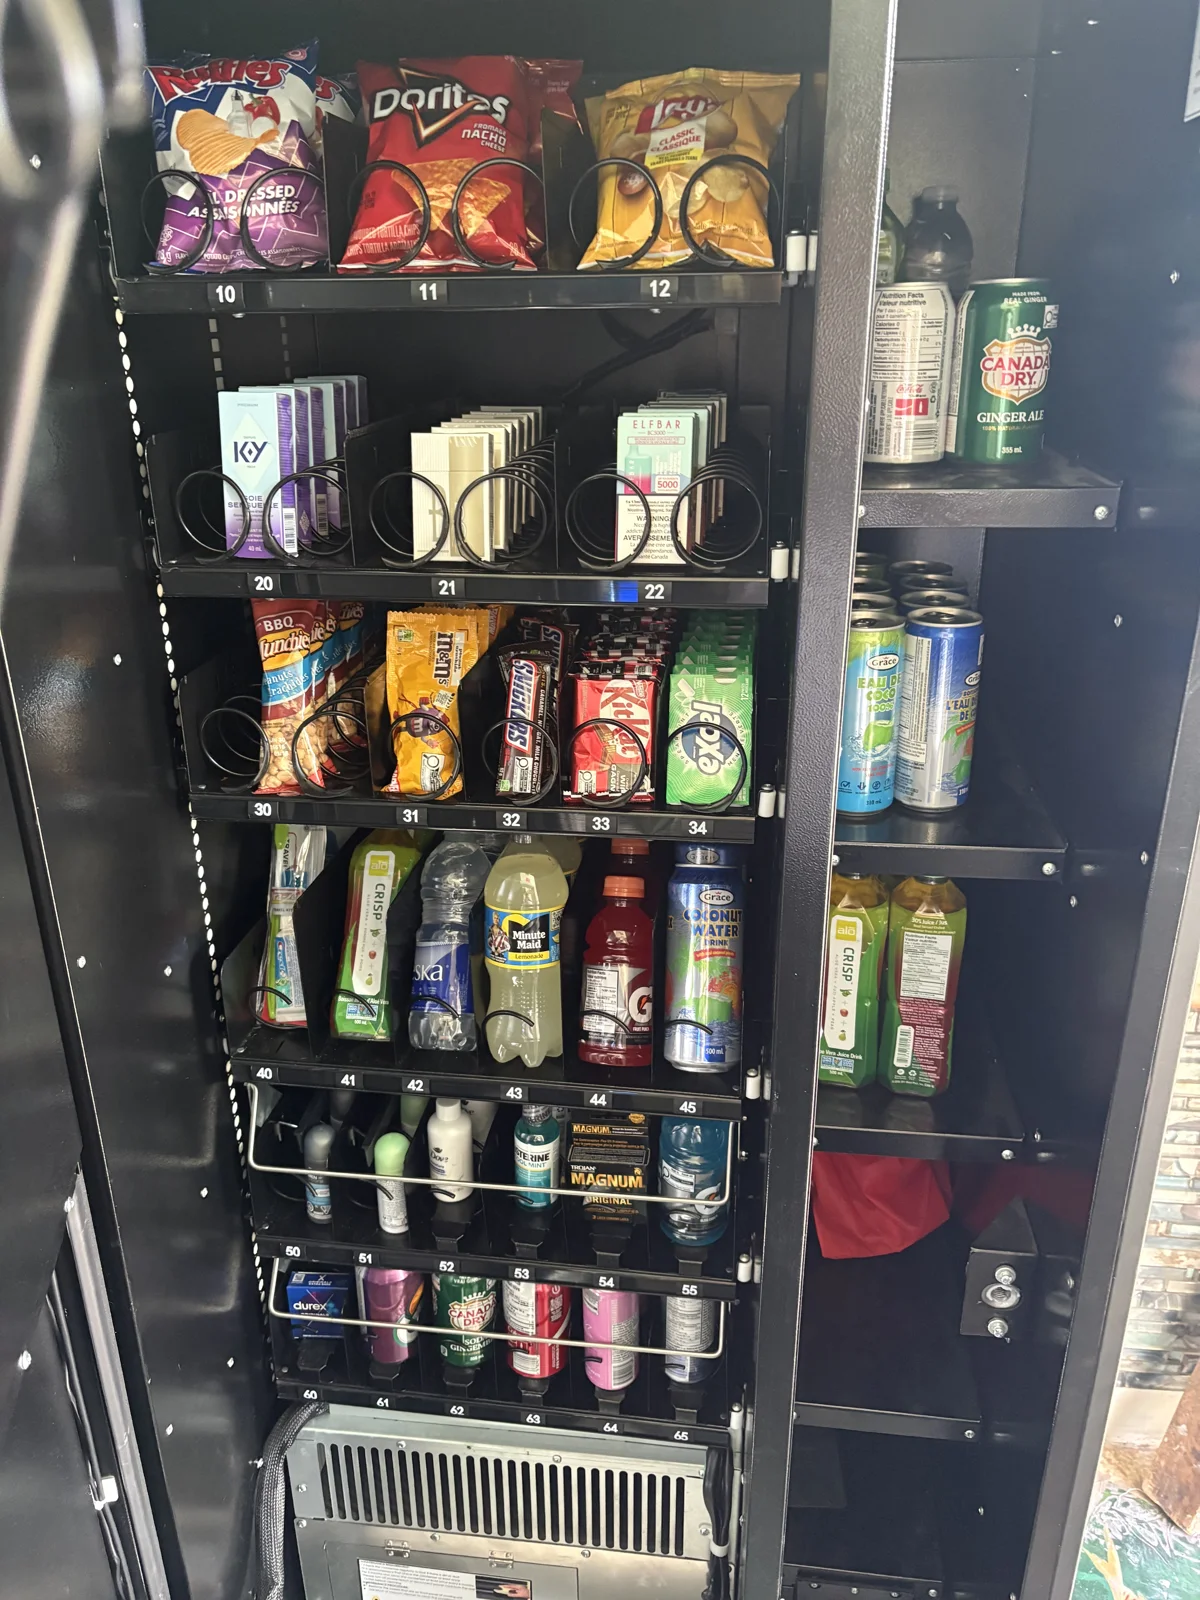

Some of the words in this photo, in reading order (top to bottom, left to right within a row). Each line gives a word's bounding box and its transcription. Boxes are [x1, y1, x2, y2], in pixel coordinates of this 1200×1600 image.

[150, 59, 291, 104] Ruffles
[373, 83, 510, 124] Doritos
[473, 123, 507, 136] FROMAGE
[461, 129, 507, 146] NACHO
[659, 128, 695, 146] CLASSIC
[480, 139, 505, 153] CHEESE
[650, 135, 702, 152] CLASSIQUE
[216, 285, 235, 303] 10
[419, 283, 437, 300] 11
[650, 279, 671, 298] 12
[981, 355, 1050, 371] CANADA
[977, 411, 1027, 423] GINGER
[1028, 410, 1044, 422] ALE
[633, 419, 681, 429] ELFBAR
[657, 480, 679, 489] 5000
[228, 501, 279, 509] SENSUEE
[254, 576, 273, 591] 20
[438, 580, 455, 595] 21
[645, 584, 664, 599] 22
[263, 616, 294, 632] BBQ
[871, 658, 897, 666] Grace
[266, 670, 293, 685] anuts
[857, 677, 887, 689] EAU
[741, 692, 748, 701] 12
[866, 687, 896, 701] COCO
[508, 660, 534, 747] SNICKRS
[674, 712, 690, 764] SPEARINT
[254, 803, 272, 816] 30
[402, 809, 418, 823] 31
[502, 813, 520, 827] 32
[592, 817, 610, 831] 33
[688, 821, 707, 835] 34
[372, 883, 386, 921] CRISP
[704, 892, 731, 901] Grace
[683, 909, 743, 922] COCONUT
[512, 930, 546, 940] Minute
[692, 924, 739, 936] WATER
[516, 940, 542, 949] Maid
[515, 952, 544, 960] Lemonade
[842, 947, 855, 982] CRISP
[412, 964, 443, 981] ska
[629, 986, 653, 1024] G
[705, 1047, 717, 1055] 500
[850, 1052, 863, 1060] Drink
[256, 1067, 272, 1079] 40
[341, 1074, 355, 1086] 41
[407, 1080, 424, 1091] 42
[506, 1087, 522, 1099] 43
[589, 1094, 607, 1106] 44
[679, 1101, 696, 1113] 45
[573, 1125, 610, 1134] MAGNUM
[571, 1172, 643, 1189] MAGNUM
[285, 1246, 301, 1257] 50
[358, 1253, 372, 1264] 51
[439, 1261, 454, 1272] 52
[514, 1268, 530, 1279] 53
[598, 1277, 614, 1288] 54
[682, 1285, 698, 1295] 55
[293, 1301, 327, 1311] durex
[449, 1297, 496, 1318] CANADA
[464, 1336, 485, 1345] SOD
[303, 1390, 317, 1400] 60
[376, 1398, 389, 1408] 61
[450, 1406, 464, 1415] 62
[526, 1414, 541, 1424] 63
[603, 1423, 618, 1433] 64
[674, 1431, 689, 1441] 65
